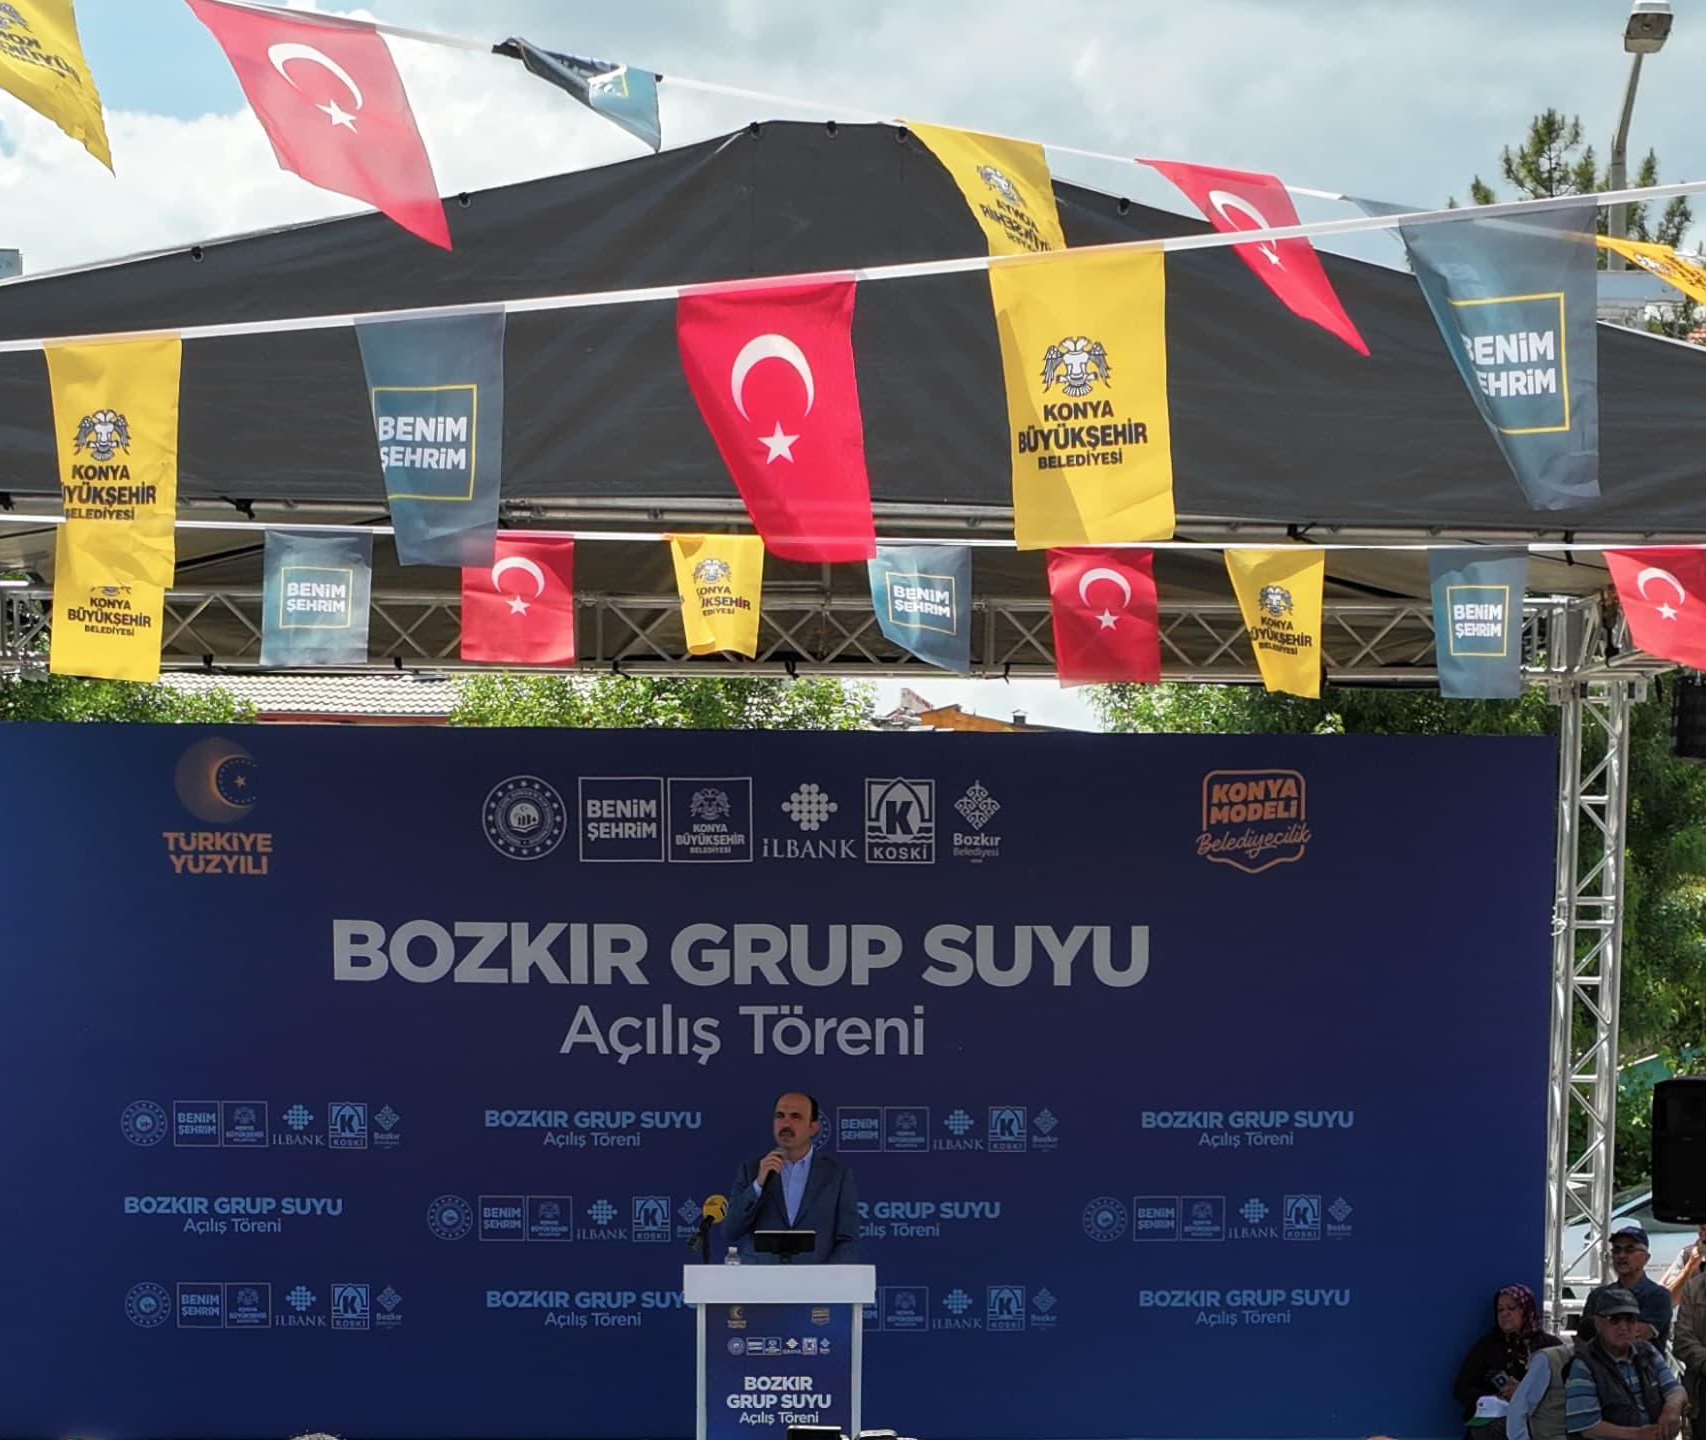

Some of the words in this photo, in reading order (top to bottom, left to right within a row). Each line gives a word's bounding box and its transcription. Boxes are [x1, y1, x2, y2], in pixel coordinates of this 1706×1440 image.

[1043, 400, 1114, 422] KONYA
[1018, 419, 1148, 454] BÜYÜKŞEHİR
[1037, 450, 1123, 470] BELEDİYESİ
[71, 465, 131, 481] KONYA
[62, 482, 157, 508] YÜKŞEHİR
[90, 597, 131, 610] KONYA
[67, 606, 152, 628] BÜYÜKŞEHİR
[1260, 617, 1294, 631] KONYA
[1211, 778, 1299, 804] KONYA
[693, 823, 728, 833] KONYA
[675, 832, 745, 847] BÜYÜKŞEHİR
[953, 832, 1001, 846] Bozkır
[1195, 822, 1313, 860] Belediyecilik
[873, 844, 928, 860] KOSKİ
[333, 918, 649, 985] BOZKIR
[671, 922, 903, 988] GRUP
[923, 923, 1150, 988] SUYU
[559, 1003, 721, 1065] Açılış
[739, 1004, 925, 1057] Töreni
[485, 1110, 568, 1127] BOZKIR
[574, 1111, 636, 1128] GRUP
[640, 1111, 701, 1129] SUYU
[1141, 1111, 1224, 1128] BOZKIR
[1229, 1111, 1290, 1128] GRUP
[1294, 1111, 1354, 1128] SUYU
[543, 1131, 586, 1148] Açılış
[591, 1131, 640, 1147] Töreni
[1198, 1131, 1241, 1148] Açılış
[1245, 1131, 1294, 1147] Töreni
[124, 1196, 208, 1214] BOZKIR
[214, 1198, 276, 1214] GRUP
[281, 1198, 343, 1216] SUYU
[874, 1202, 935, 1219] GRUP
[940, 1202, 1001, 1219] SUYU
[183, 1218, 227, 1235] Açılış
[231, 1218, 282, 1233] Töreni
[859, 1223, 886, 1239] çılış
[891, 1223, 940, 1237] Töreni
[486, 1290, 570, 1308] BOZKIR
[575, 1291, 636, 1309] GRUP
[641, 1291, 693, 1309] SUY
[1139, 1290, 1221, 1307] BOZKIR
[1225, 1290, 1286, 1306] GRUP
[1291, 1289, 1350, 1306] SUYU
[544, 1312, 587, 1328] Açılış
[591, 1312, 641, 1327] Töreni
[1195, 1310, 1238, 1327] Açılış
[1241, 1310, 1291, 1325] Töreni
[744, 1376, 813, 1391] BOZKIR
[726, 1394, 778, 1409] GRUP
[780, 1394, 832, 1409] SUYU
[739, 1411, 775, 1426] Açılış
[777, 1411, 819, 1424] Töreni
